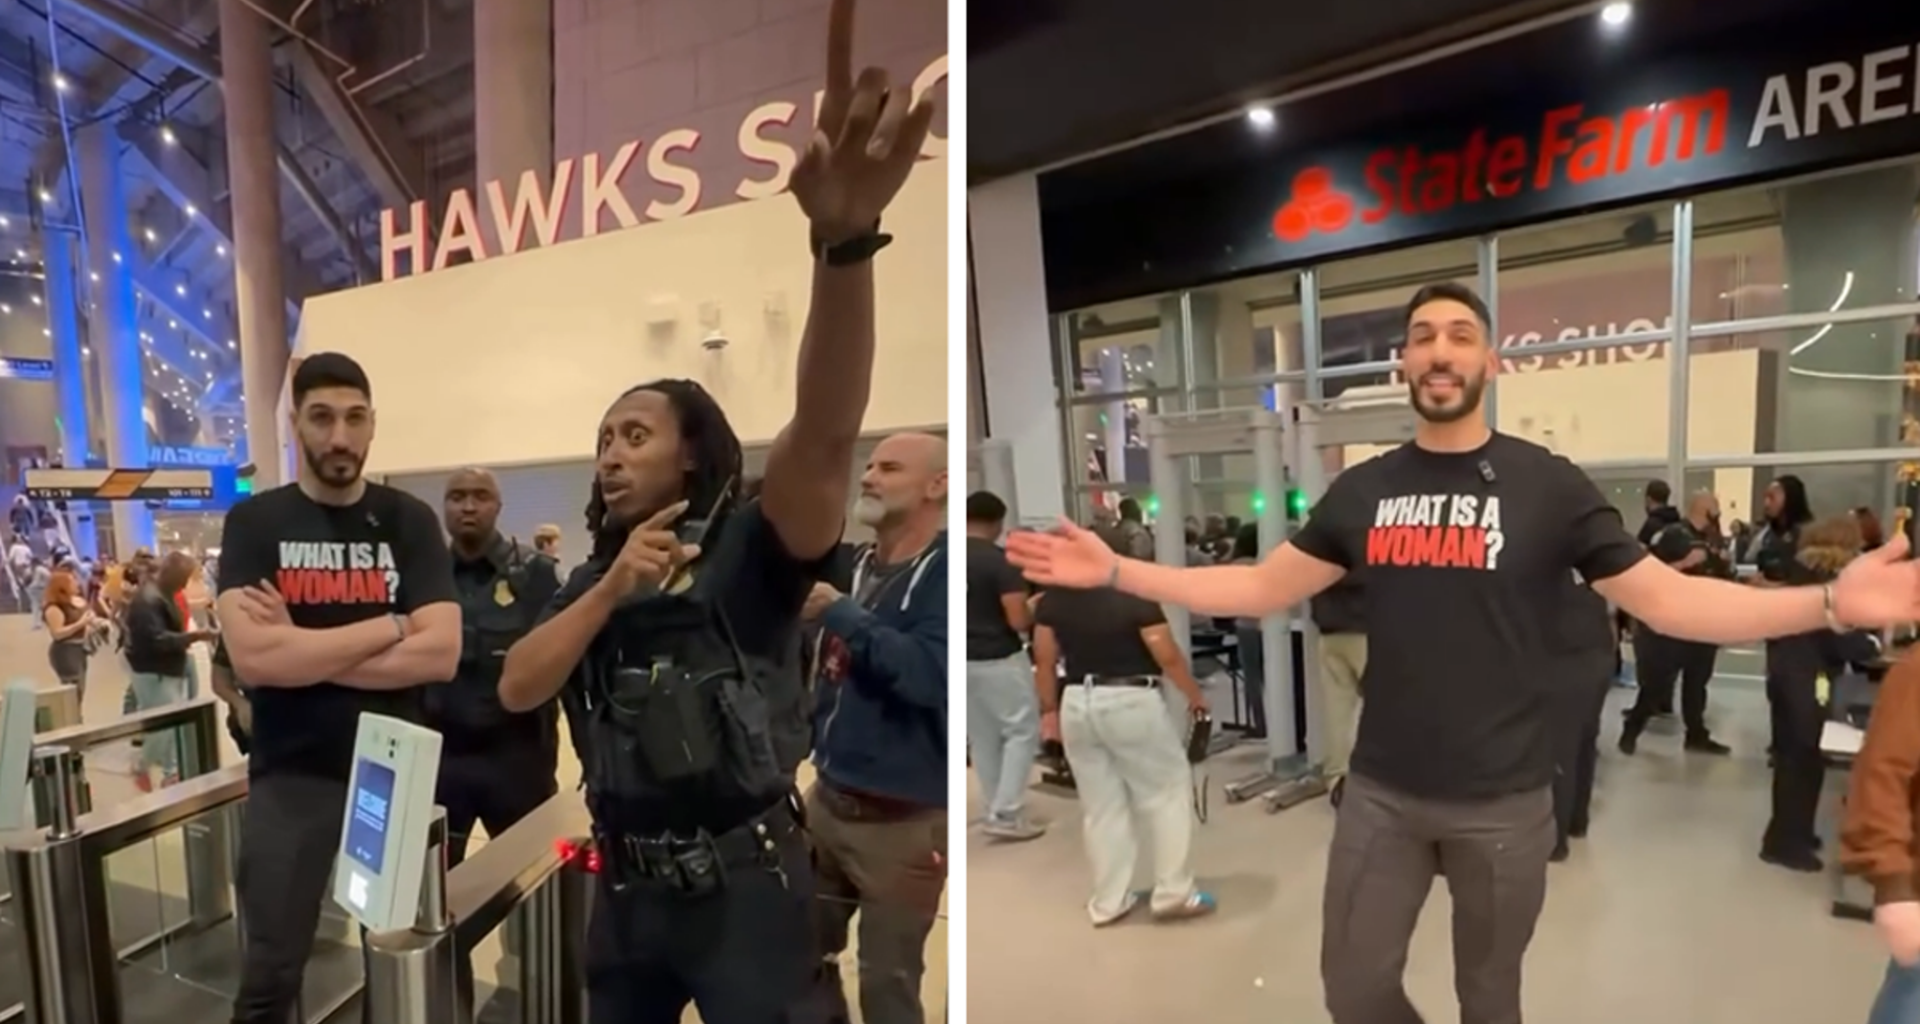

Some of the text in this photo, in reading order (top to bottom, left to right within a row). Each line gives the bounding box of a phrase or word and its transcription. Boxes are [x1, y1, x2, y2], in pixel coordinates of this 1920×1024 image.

[1747, 42, 1920, 147] ARE
[380, 128, 701, 282] HAWKS
[1556, 316, 1674, 371] SHO
[1374, 493, 1501, 530] WHAT IS A
[279, 541, 396, 570] WHAT IS A
[1366, 525, 1505, 571] WOMAN?
[276, 568, 400, 604] WOMAN?
